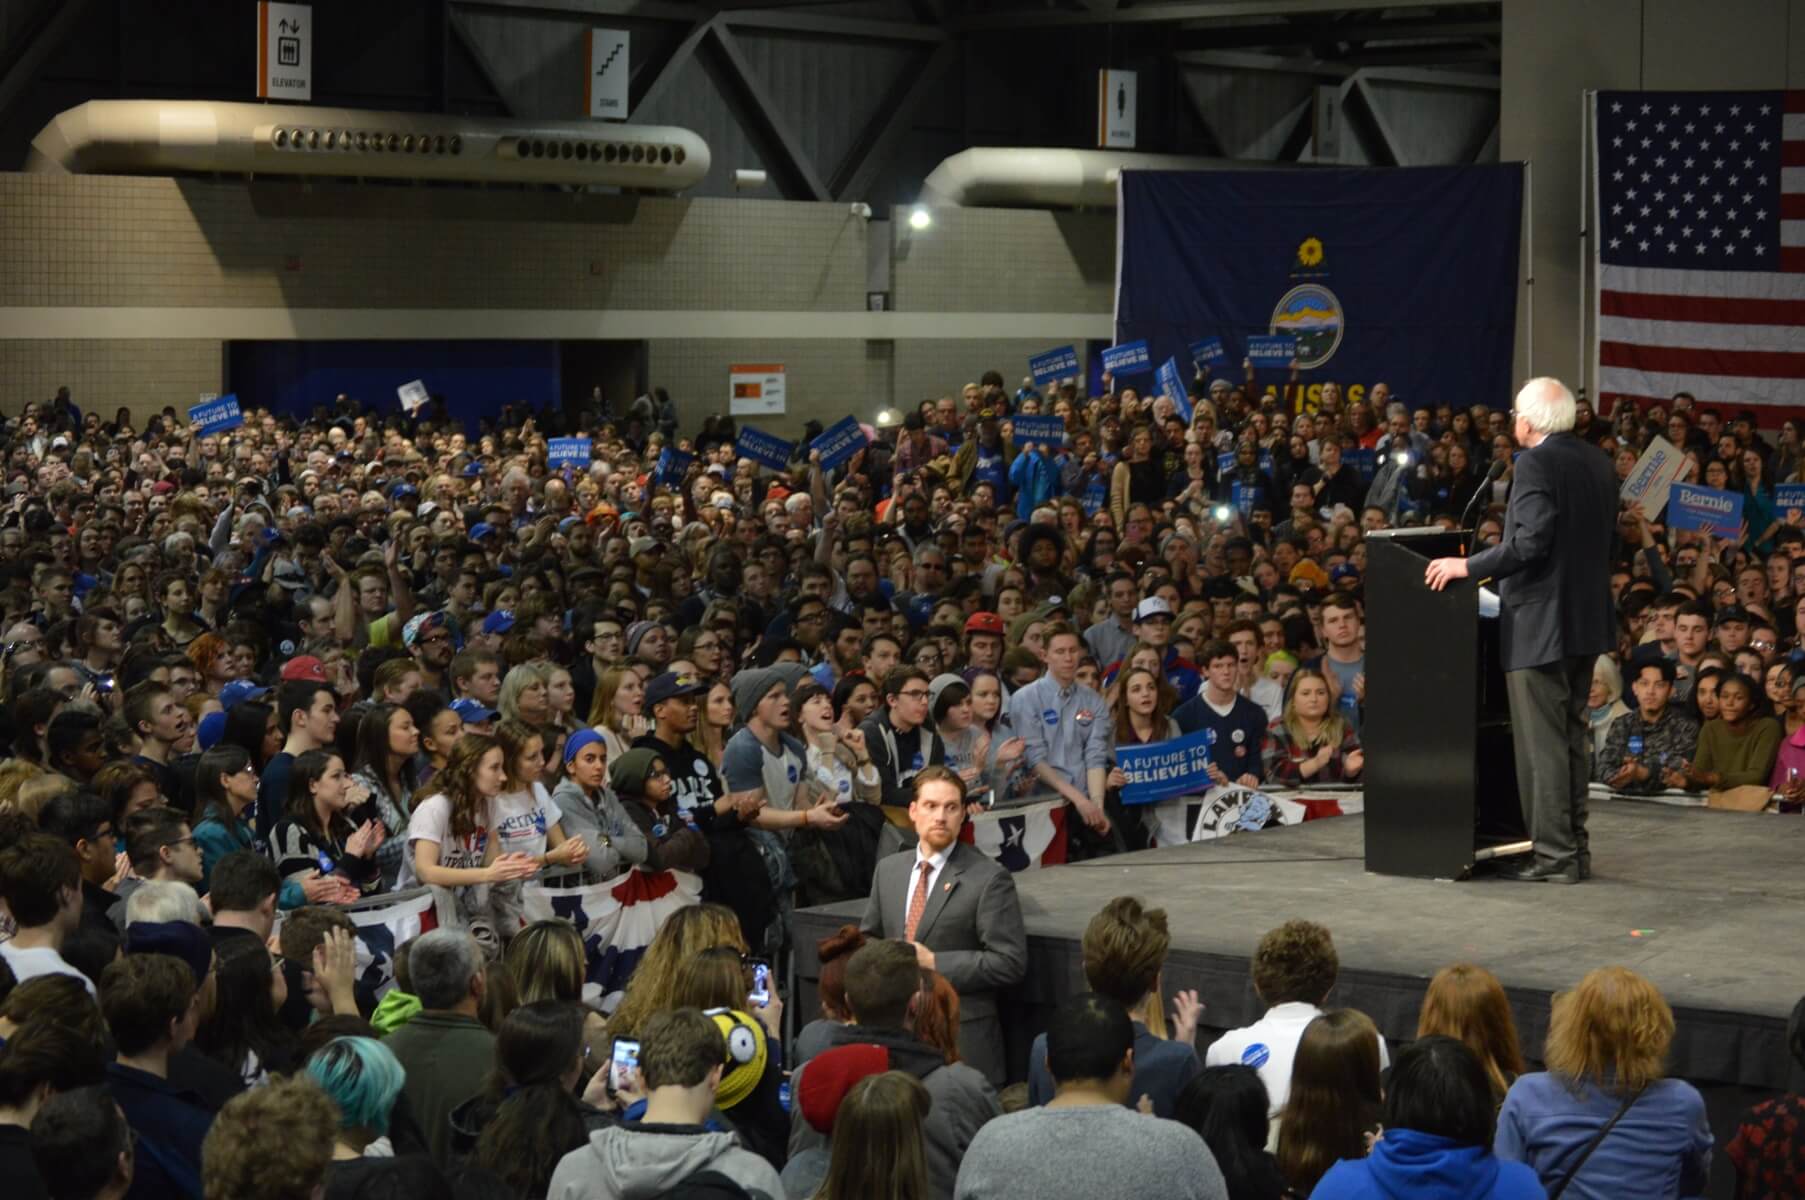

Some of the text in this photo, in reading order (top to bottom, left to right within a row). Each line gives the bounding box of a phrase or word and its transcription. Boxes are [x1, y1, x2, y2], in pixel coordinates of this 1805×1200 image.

[272, 77, 306, 88] ELEVATOR
[1104, 353, 1150, 370] BELIEVE IN
[1249, 349, 1296, 357] BELIEVE IN
[1033, 358, 1077, 377] BELIEVE IN
[226, 400, 238, 409] TO
[228, 407, 240, 418] IN
[1014, 428, 1063, 438] BELIEVE IN
[549, 450, 590, 458] BELIEVE IN
[739, 438, 786, 464] BELIEVE IN
[1628, 450, 1666, 496] Bernie
[1679, 489, 1734, 513] Bernie
[1122, 745, 1207, 770] A FUTURE TO
[1125, 757, 1210, 784] BELIEVE IN
